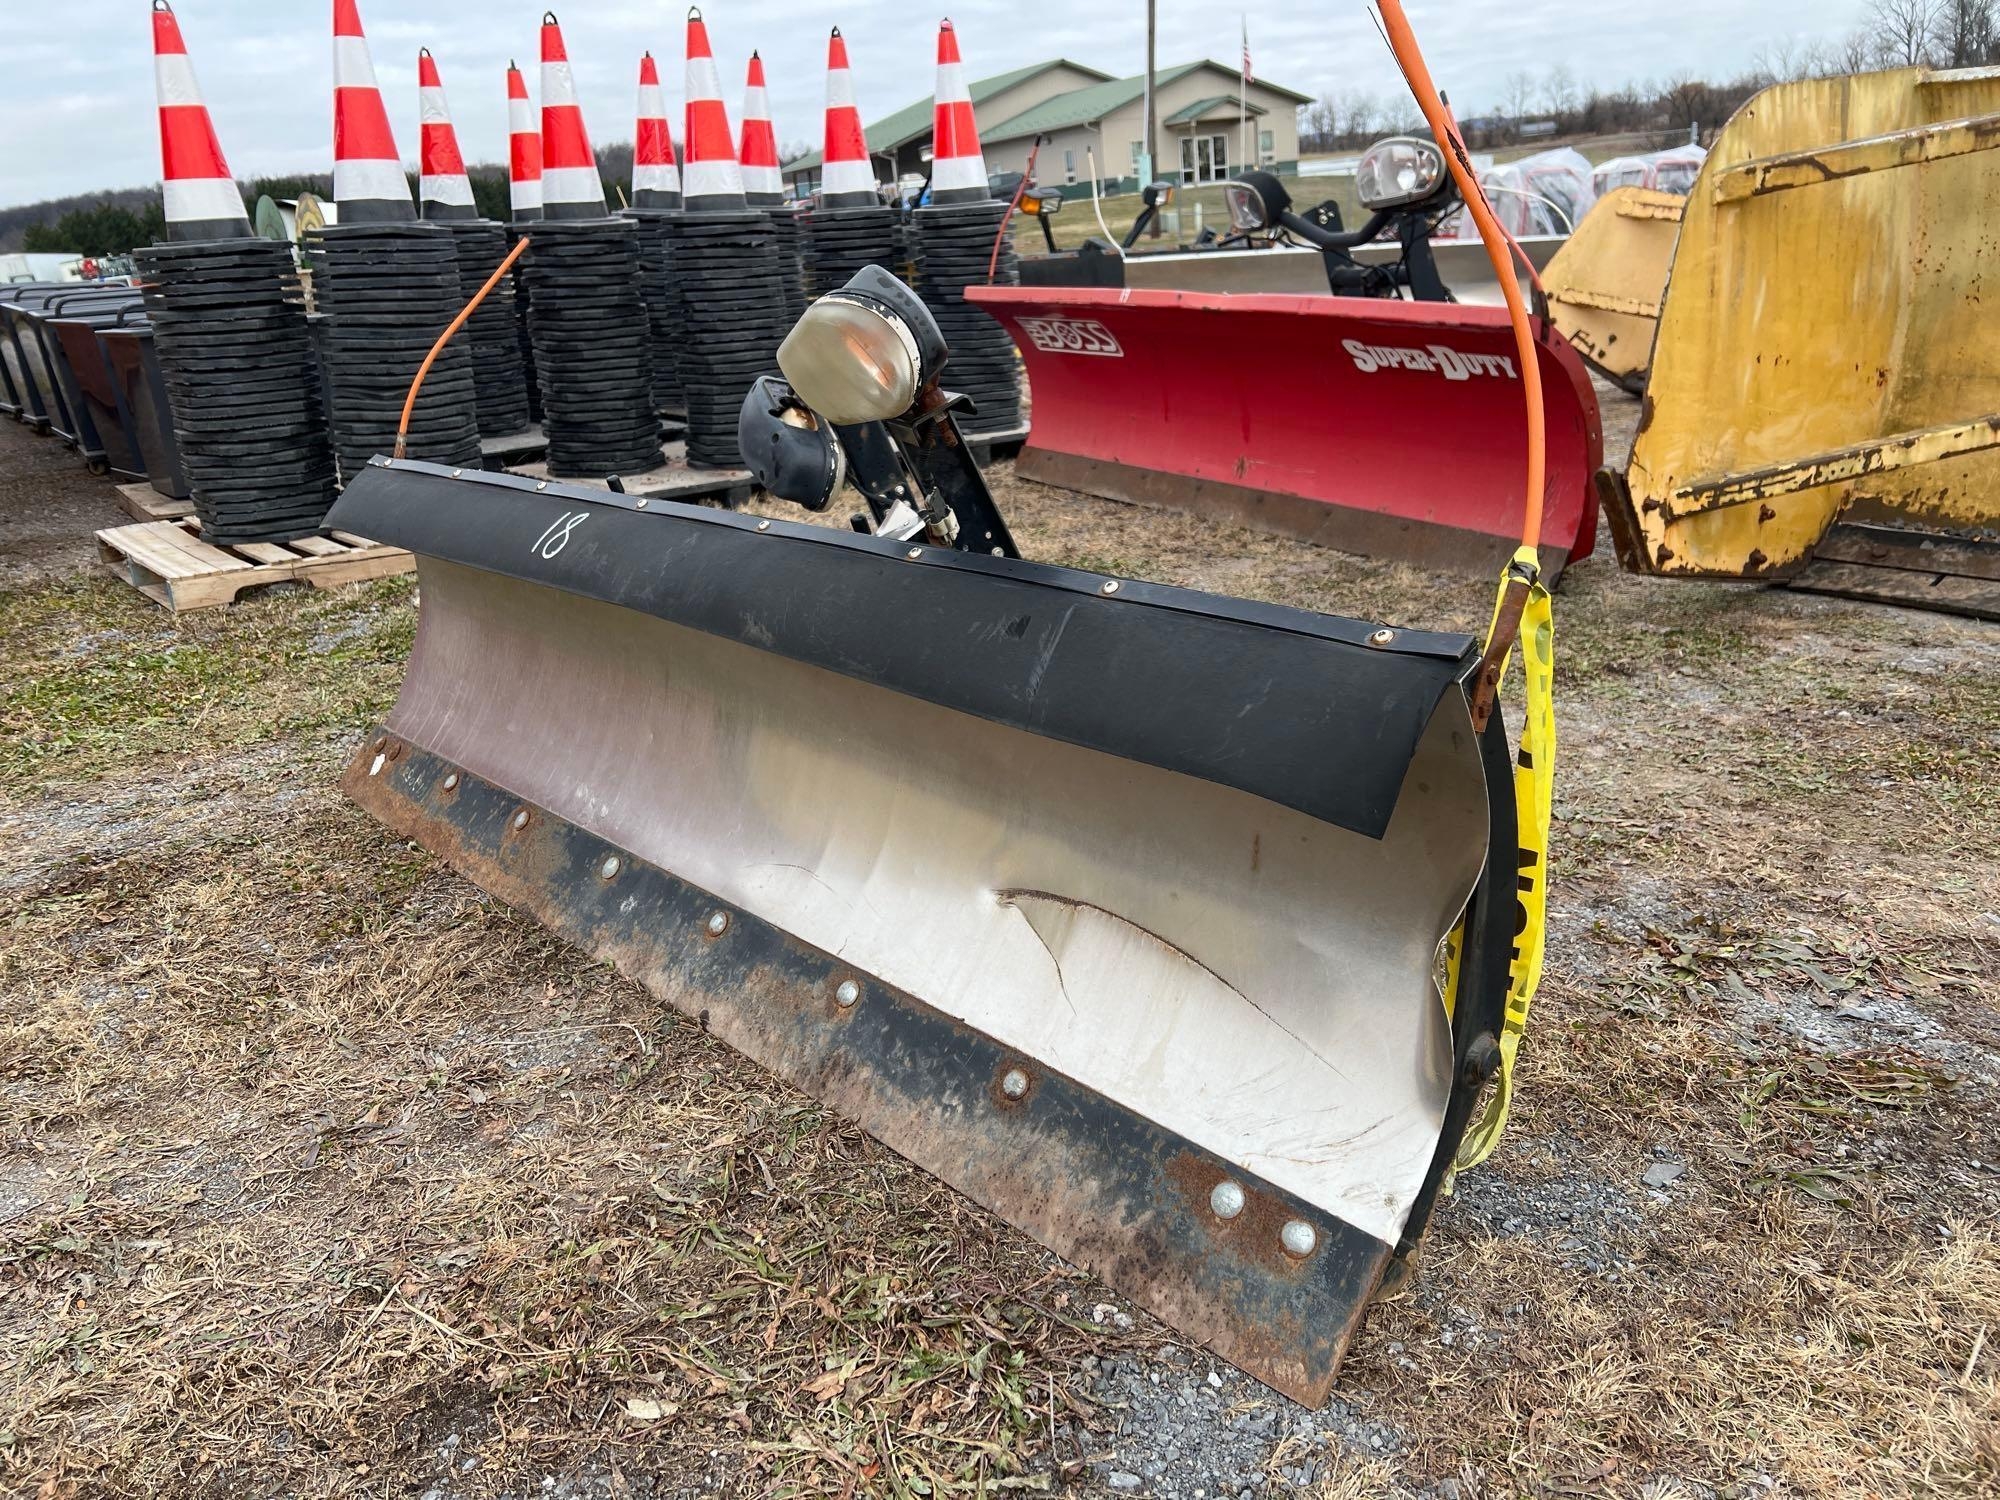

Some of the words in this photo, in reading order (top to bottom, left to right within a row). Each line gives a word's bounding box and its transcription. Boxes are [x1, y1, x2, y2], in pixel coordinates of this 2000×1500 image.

[1031, 320, 1117, 352] BOSS
[1341, 339, 1518, 381] SUPER-DUTY
[531, 511, 590, 559] 18
